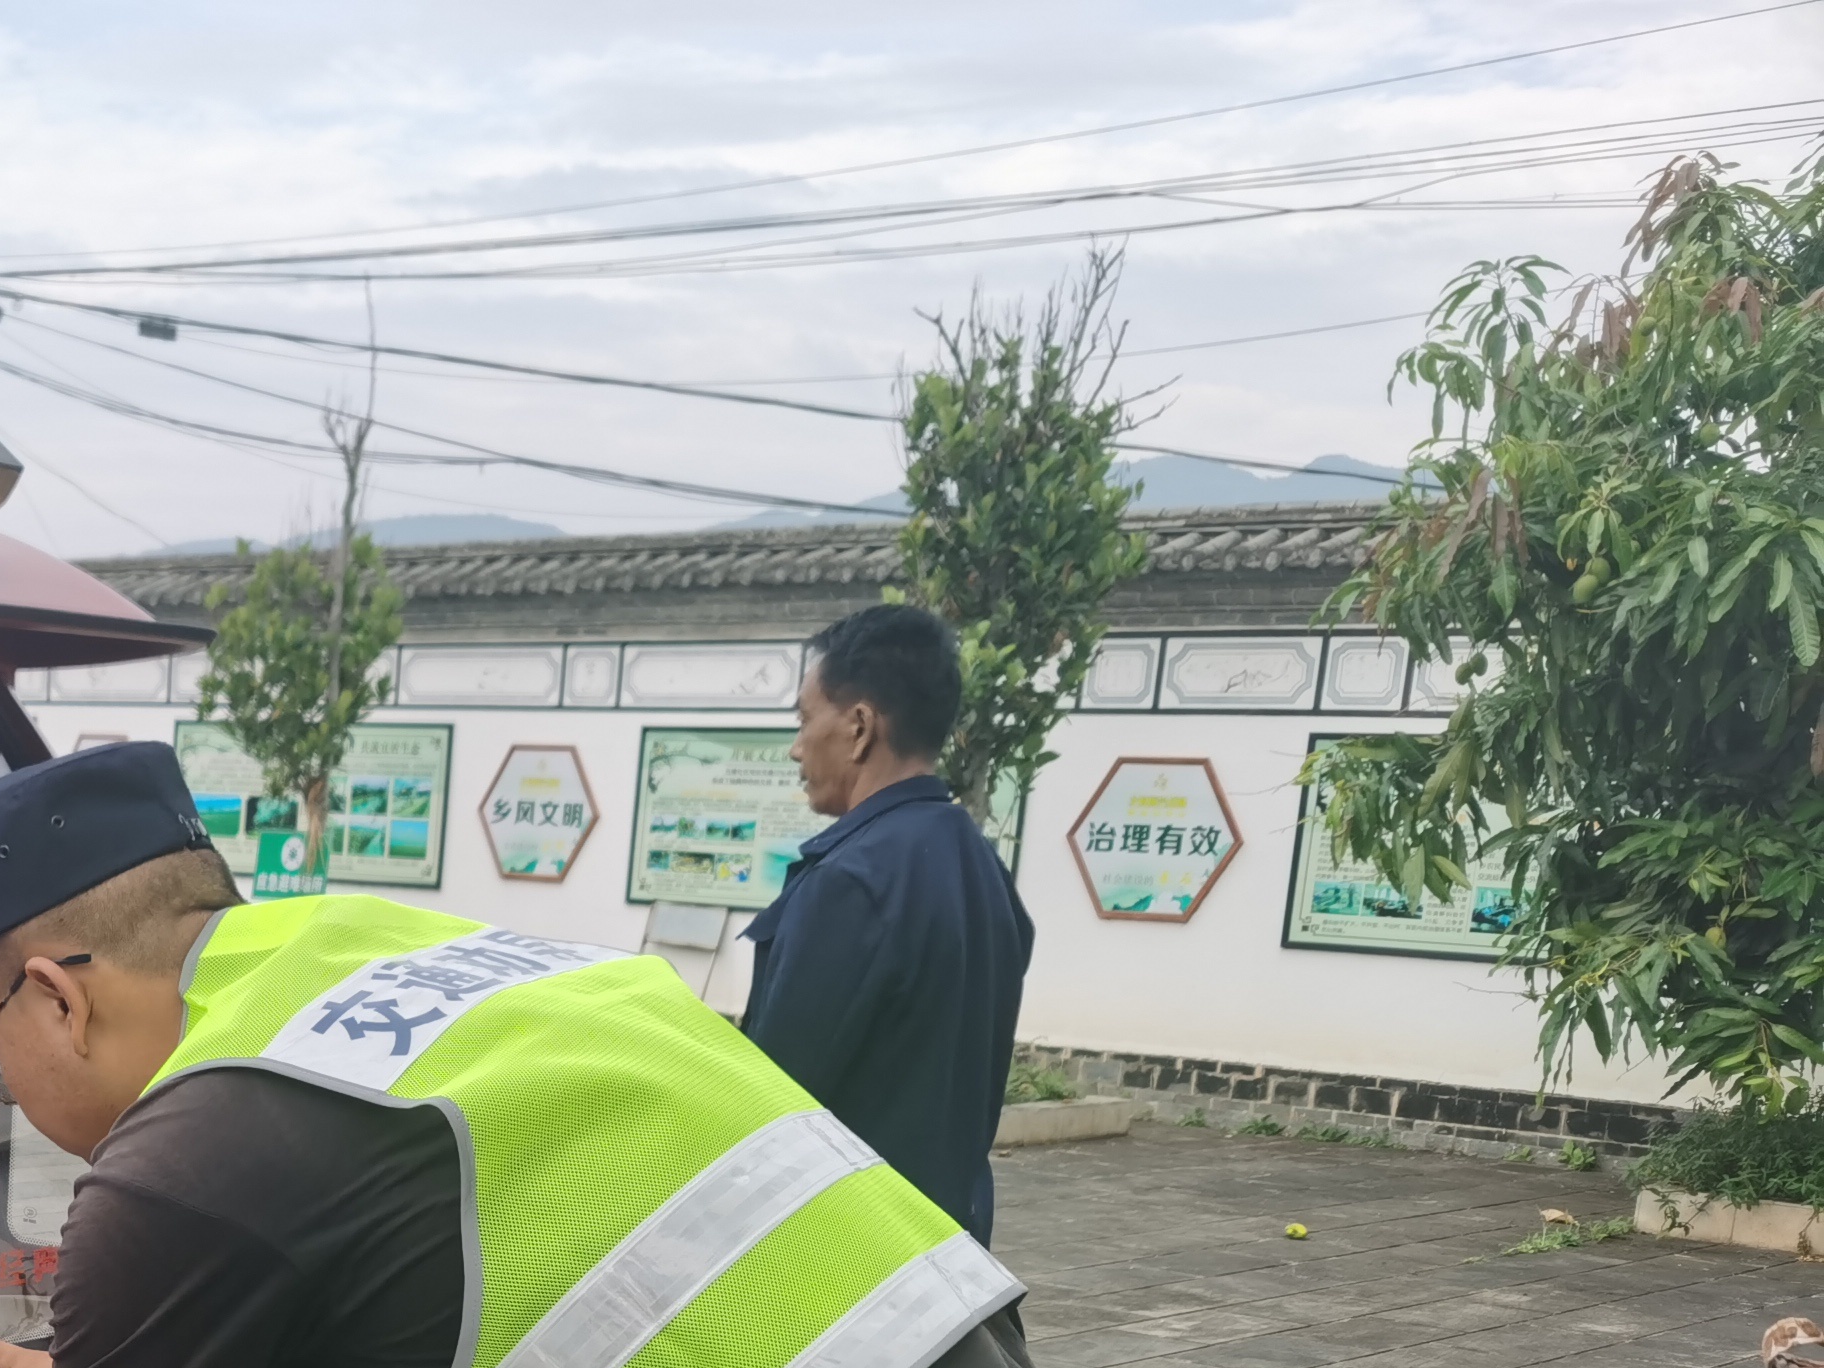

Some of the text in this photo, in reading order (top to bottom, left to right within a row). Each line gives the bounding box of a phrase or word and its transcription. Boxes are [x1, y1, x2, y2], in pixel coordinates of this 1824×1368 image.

[491, 798, 583, 828] 乡风文明
[1085, 822, 1222, 856] 治理有效
